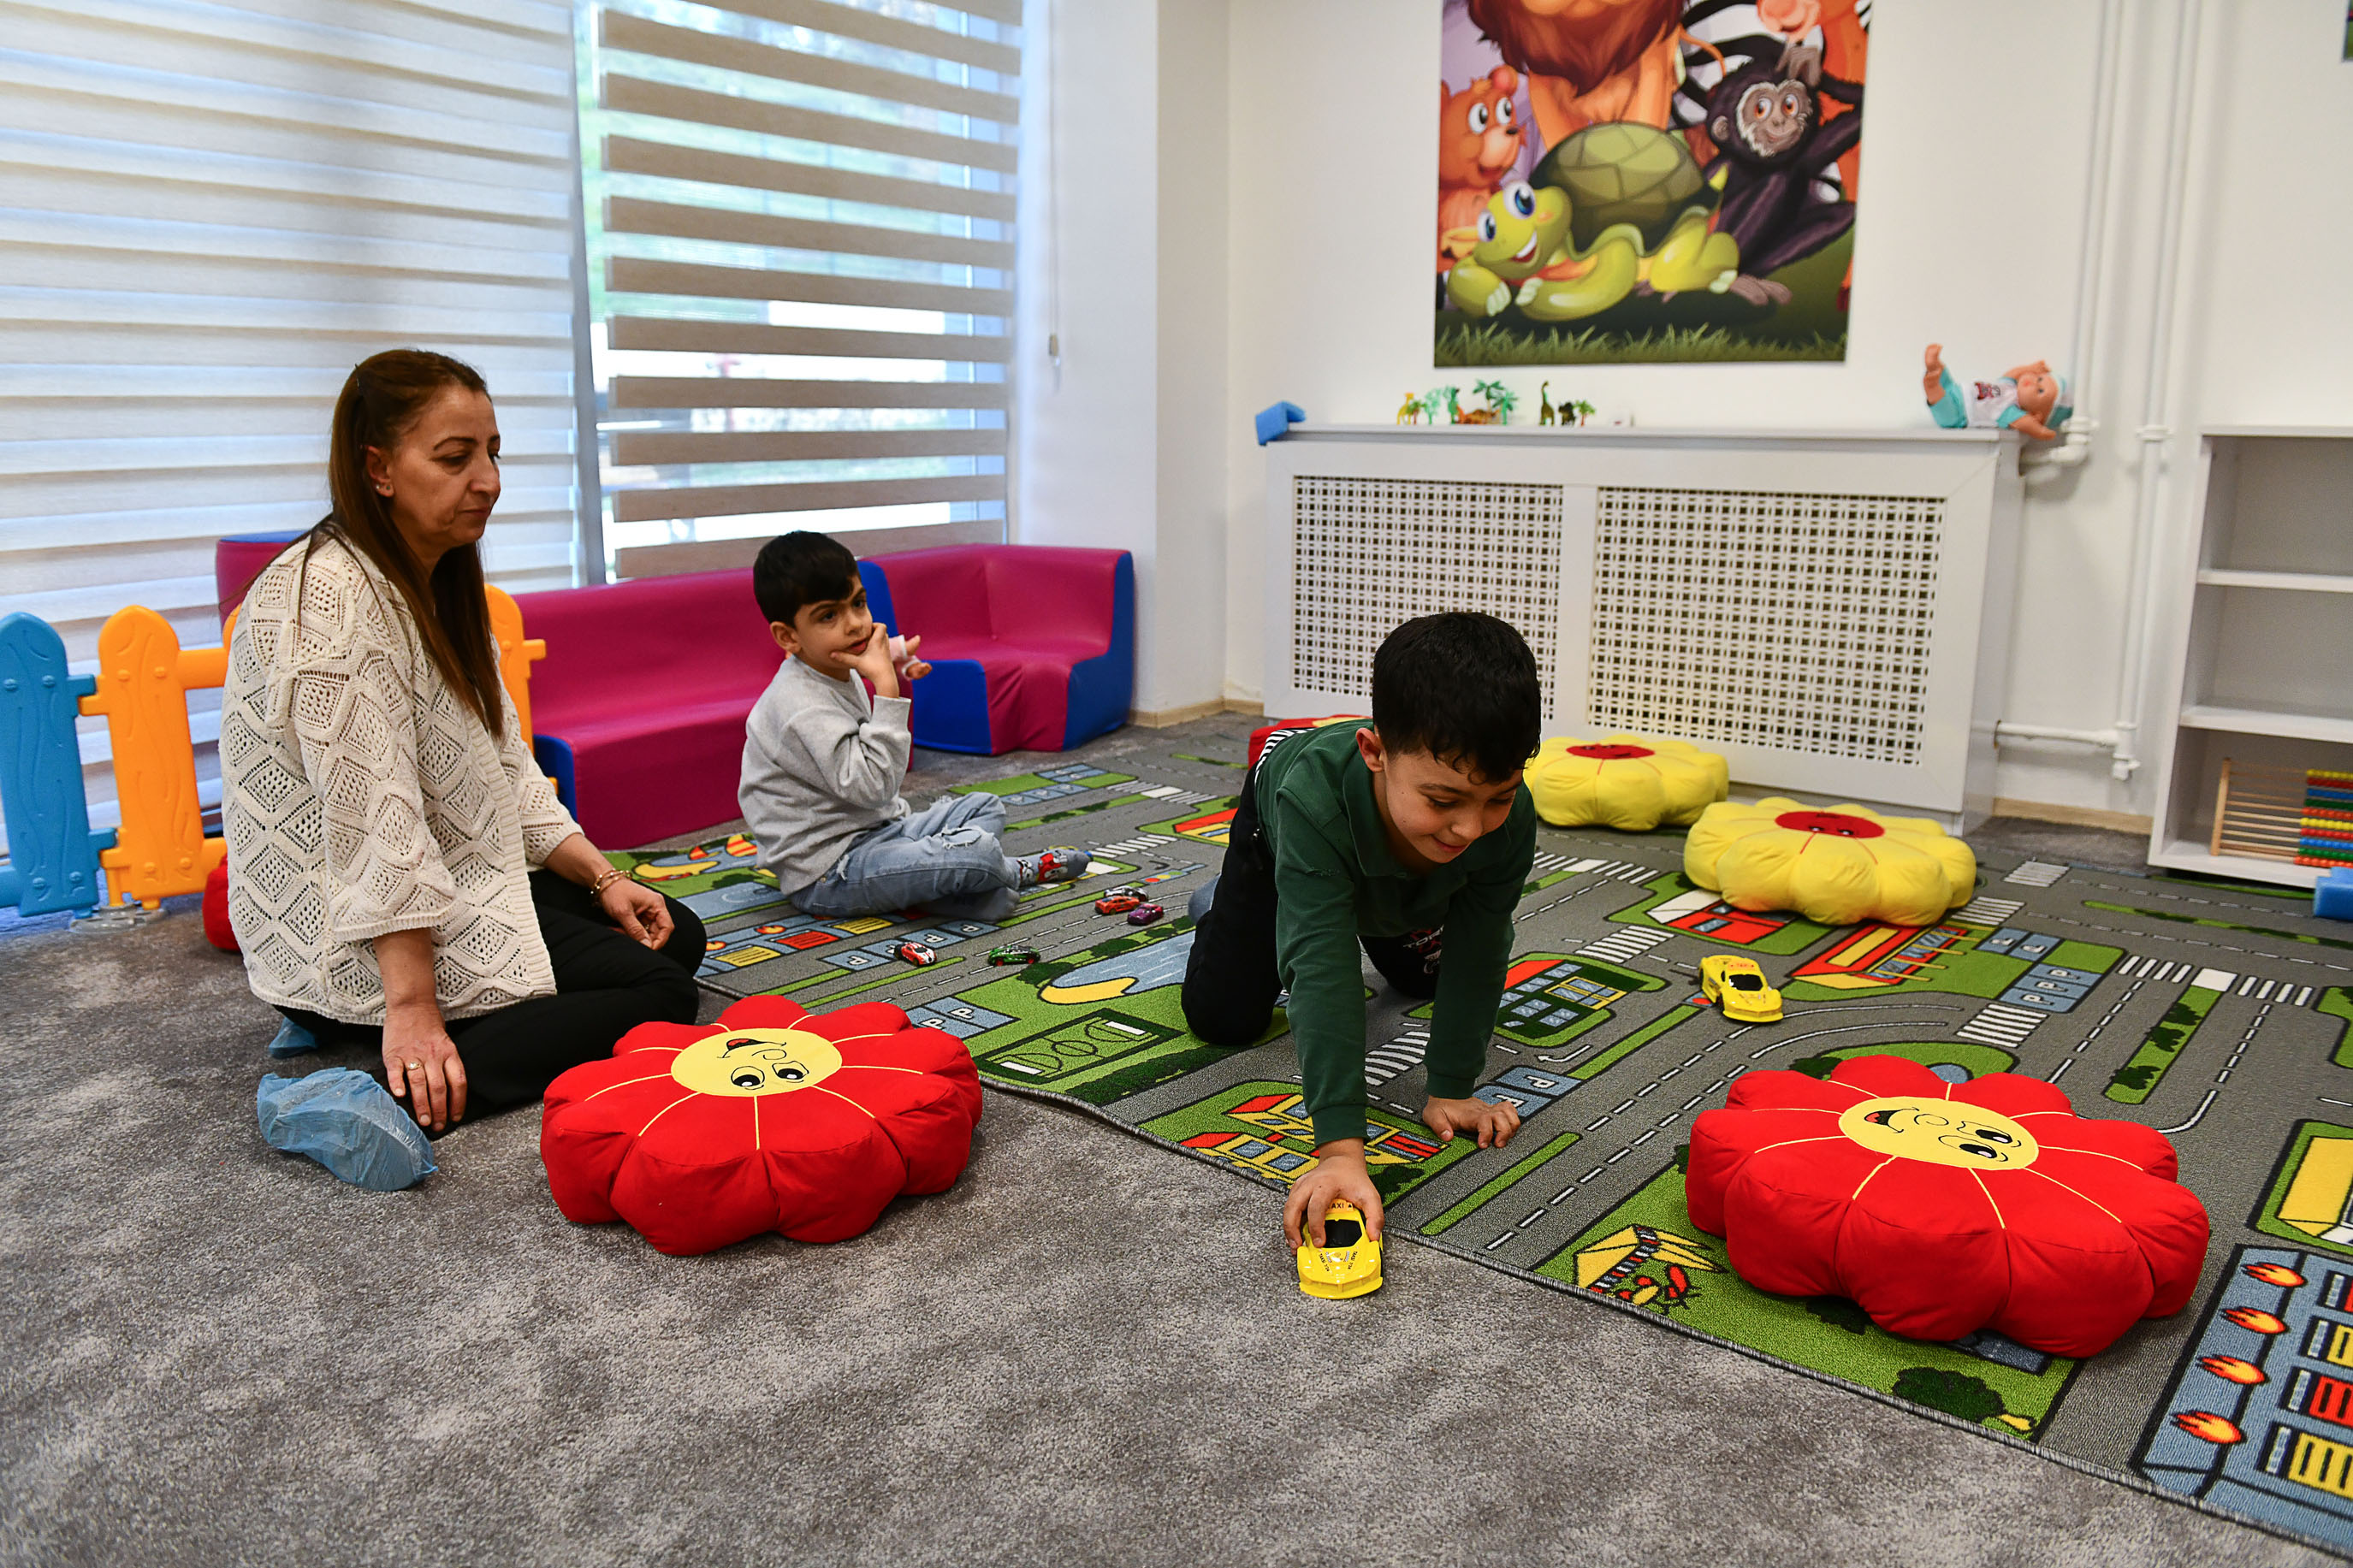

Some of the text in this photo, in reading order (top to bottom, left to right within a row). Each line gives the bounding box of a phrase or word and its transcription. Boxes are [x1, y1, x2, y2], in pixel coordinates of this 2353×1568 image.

[927, 933, 944, 943] P
[849, 956, 869, 965] P
[2049, 968, 2079, 979] P
[2036, 980, 2067, 991] P
[2021, 993, 2054, 1005] P
[950, 1008, 974, 1019] P
[921, 1018, 945, 1029] P
[1526, 1074, 1556, 1089] P
